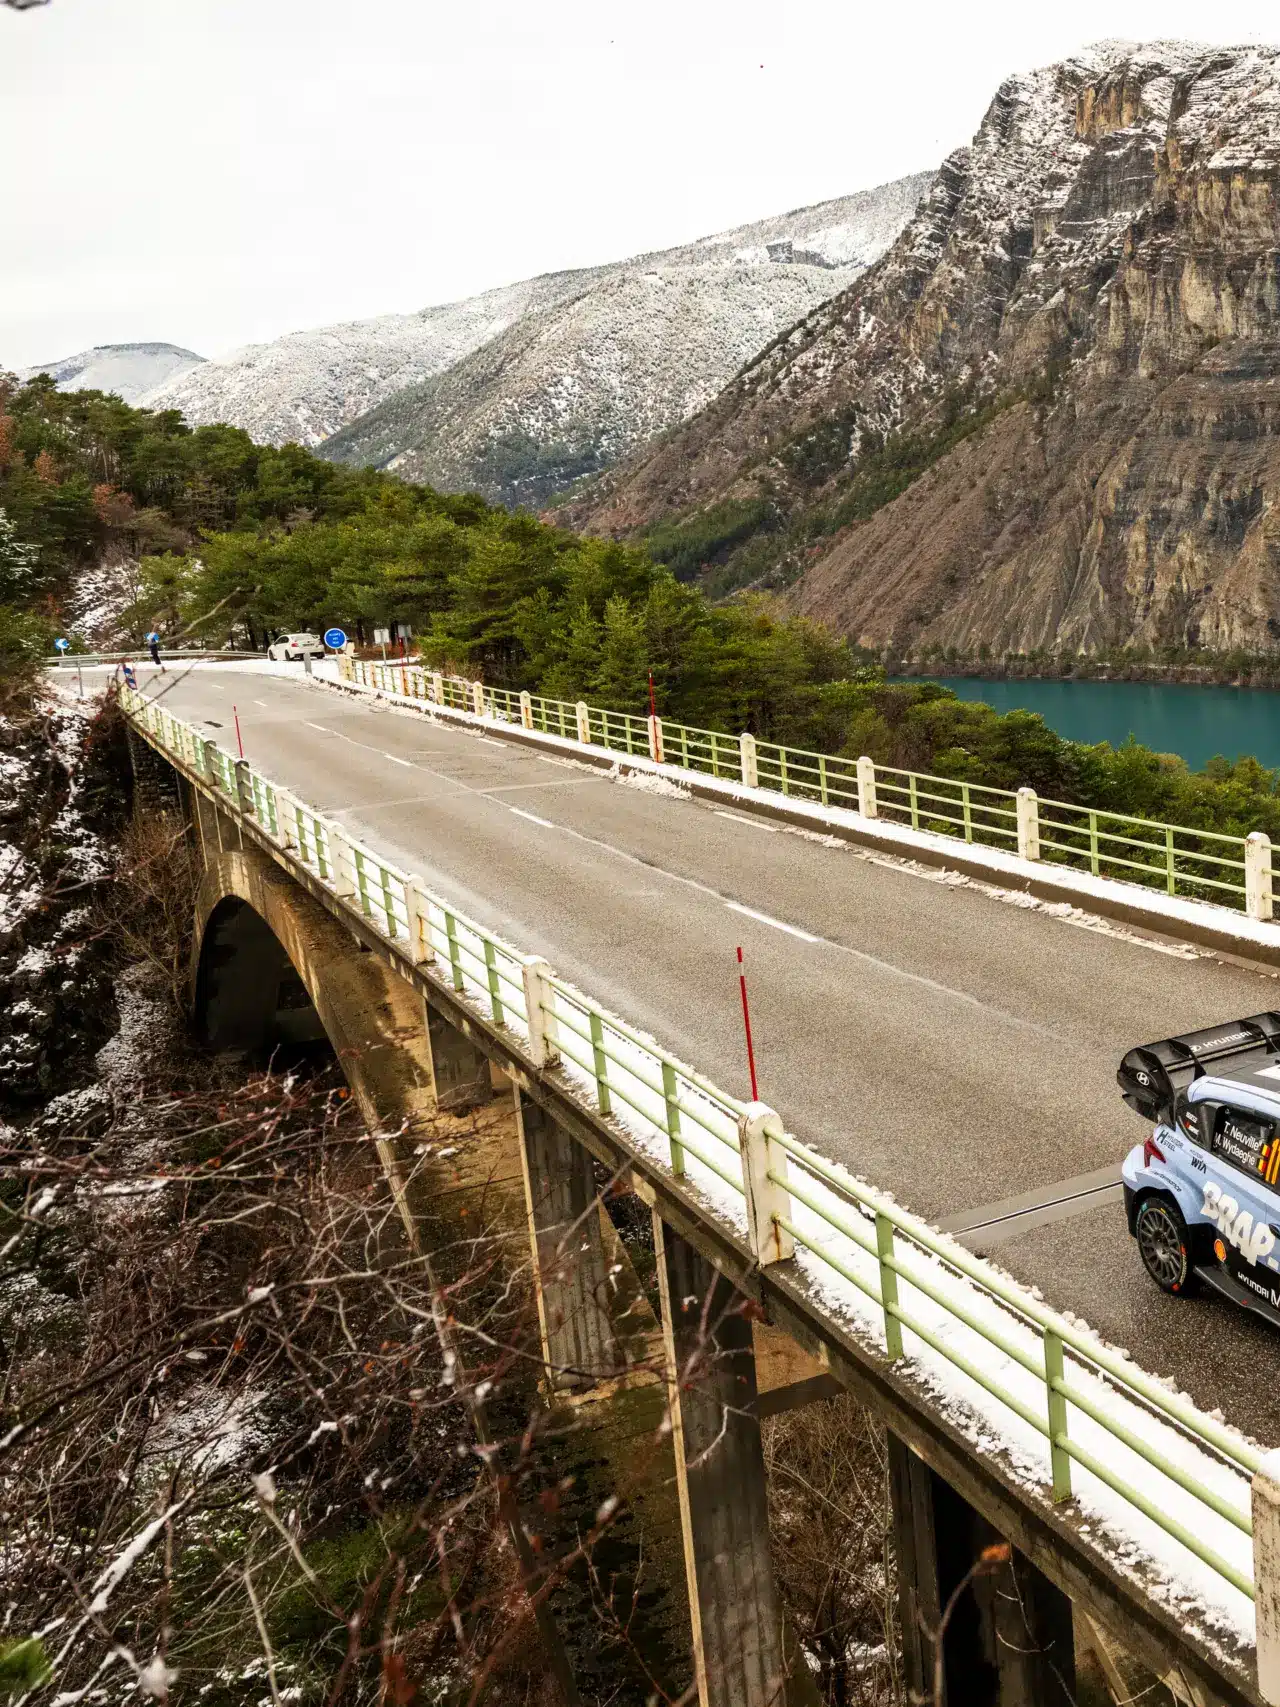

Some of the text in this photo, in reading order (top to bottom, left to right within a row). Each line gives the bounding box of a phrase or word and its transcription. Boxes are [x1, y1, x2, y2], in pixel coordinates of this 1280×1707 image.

[1202, 1031, 1253, 1049] HYUNDAI
[1163, 1140, 1176, 1152] STEEL
[1224, 1121, 1260, 1151] T. Neuville
[1222, 1137, 1256, 1165] Wydaeghe
[1237, 1271, 1270, 1299] HYUNDAI
